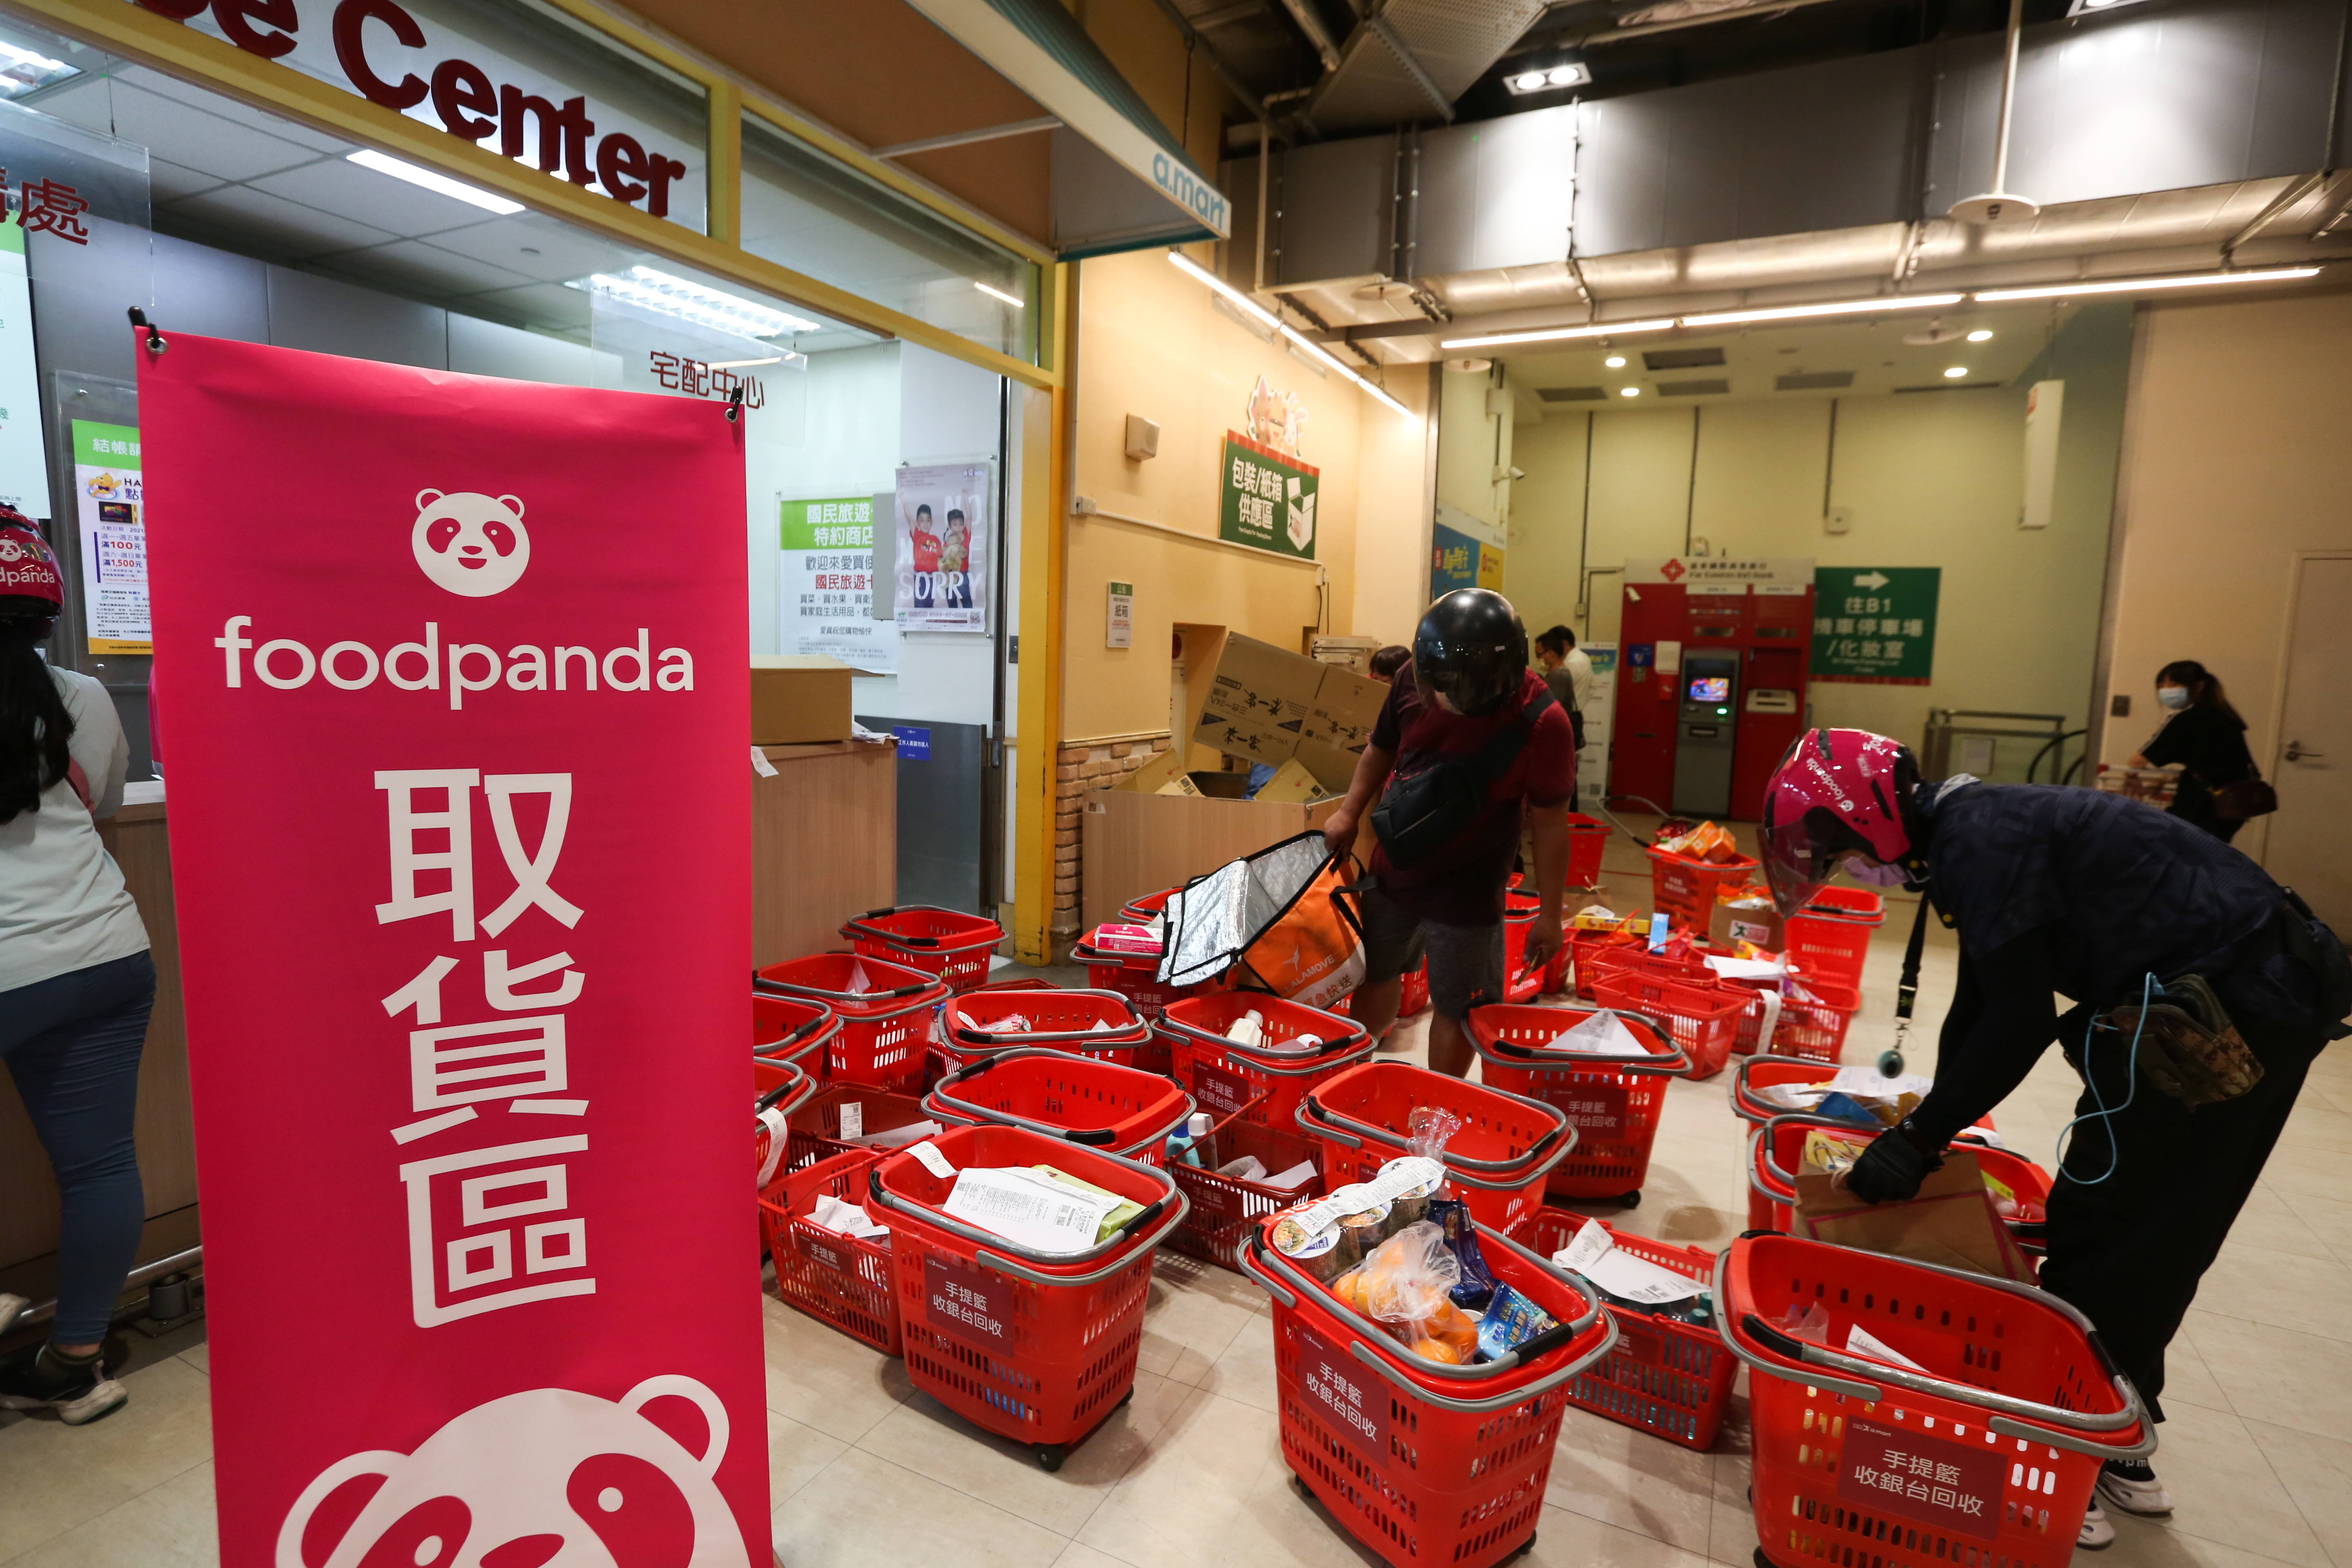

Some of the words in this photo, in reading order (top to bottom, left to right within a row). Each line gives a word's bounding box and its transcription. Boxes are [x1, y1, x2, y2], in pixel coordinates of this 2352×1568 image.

[333, 0, 685, 217] Center
[0, 168, 89, 246] 處
[1153, 152, 1225, 229] a.mart
[650, 350, 764, 409] 宅配中心
[125, 488, 143, 501] 點
[1232, 456, 1283, 503] 包裝/紙箱
[806, 502, 873, 524] 國民旅遊
[1238, 492, 1274, 530] 供應區
[899, 571, 983, 600] SORRY
[820, 627, 872, 635] 愛買祝您購物愉快
[214, 615, 694, 710] foodpanda
[1284, 954, 1335, 993] LALAMOVE
[1134, 993, 1162, 1003] 手提籃
[374, 768, 596, 1328] 取貨區
[1198, 1088, 1242, 1113] 收銀台回收
[1206, 1078, 1234, 1099] 手提籃
[1568, 1101, 1606, 1114] 手提籃
[1193, 1187, 1222, 1204] 手提籃
[811, 1243, 837, 1264] 手提籃
[945, 1281, 987, 1312] 手提籃
[933, 1294, 1002, 1338] 收銀台回收
[1319, 1361, 1362, 1408] 手提籃
[1307, 1372, 1377, 1442] 收銀台回收
[1870, 1428, 1891, 1437] a.mart
[1882, 1449, 1961, 1486] 手提籃
[1854, 1465, 1984, 1517] 收銀台回收
